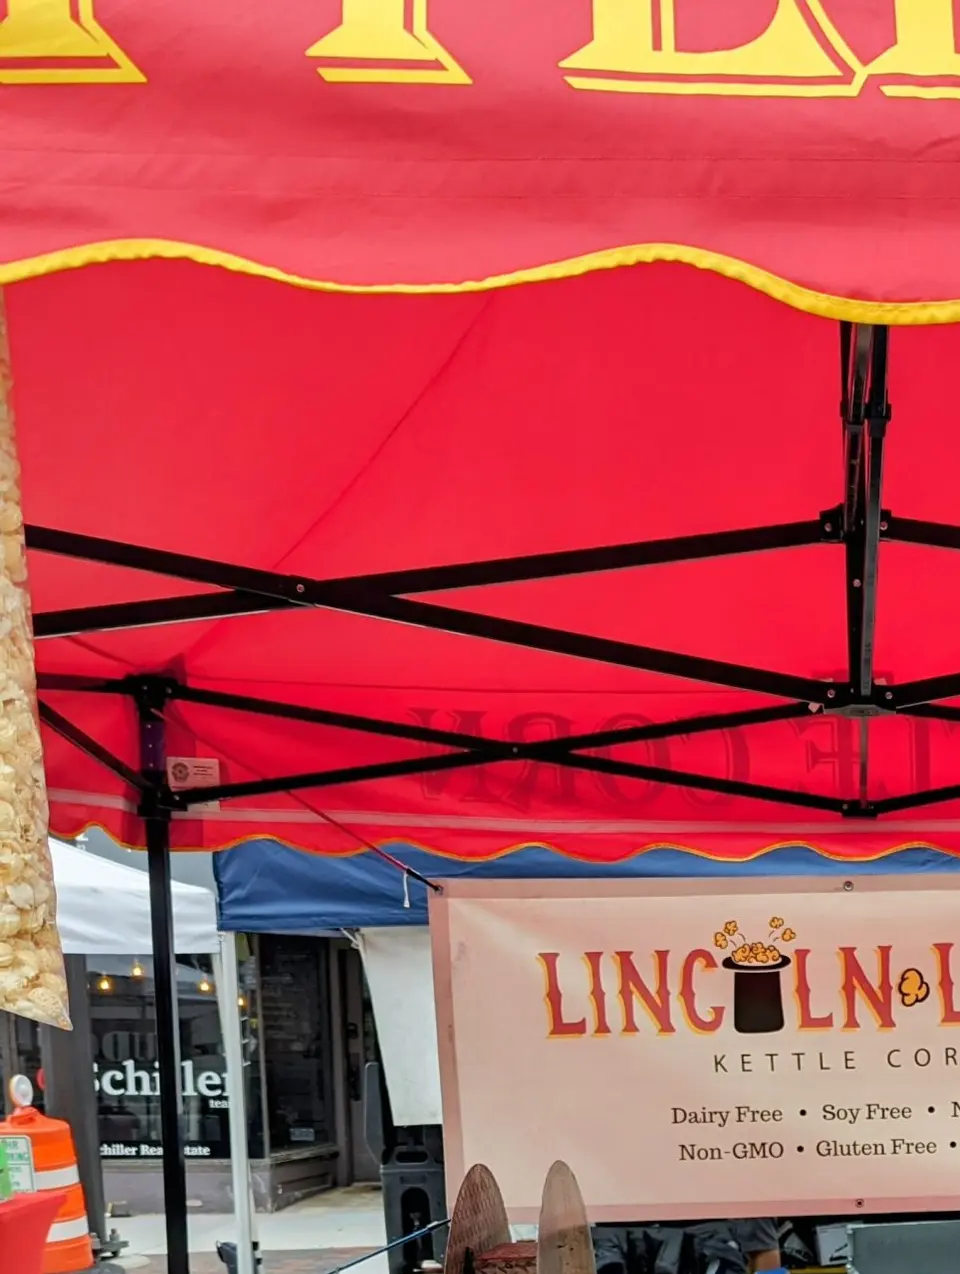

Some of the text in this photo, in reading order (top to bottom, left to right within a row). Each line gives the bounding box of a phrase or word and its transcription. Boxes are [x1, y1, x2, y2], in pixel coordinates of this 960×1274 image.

[536, 944, 897, 1039] LINCLN
[714, 1051, 856, 1073] KETTLE
[671, 1107, 730, 1127] Dairy
[735, 1106, 783, 1123] Free
[822, 1104, 861, 1124] Soy
[866, 1103, 912, 1120] Free
[140, 1144, 164, 1156] Rea
[679, 1142, 784, 1161] Non-GMO
[816, 1140, 886, 1157] Gluten
[890, 1139, 938, 1155] Free
